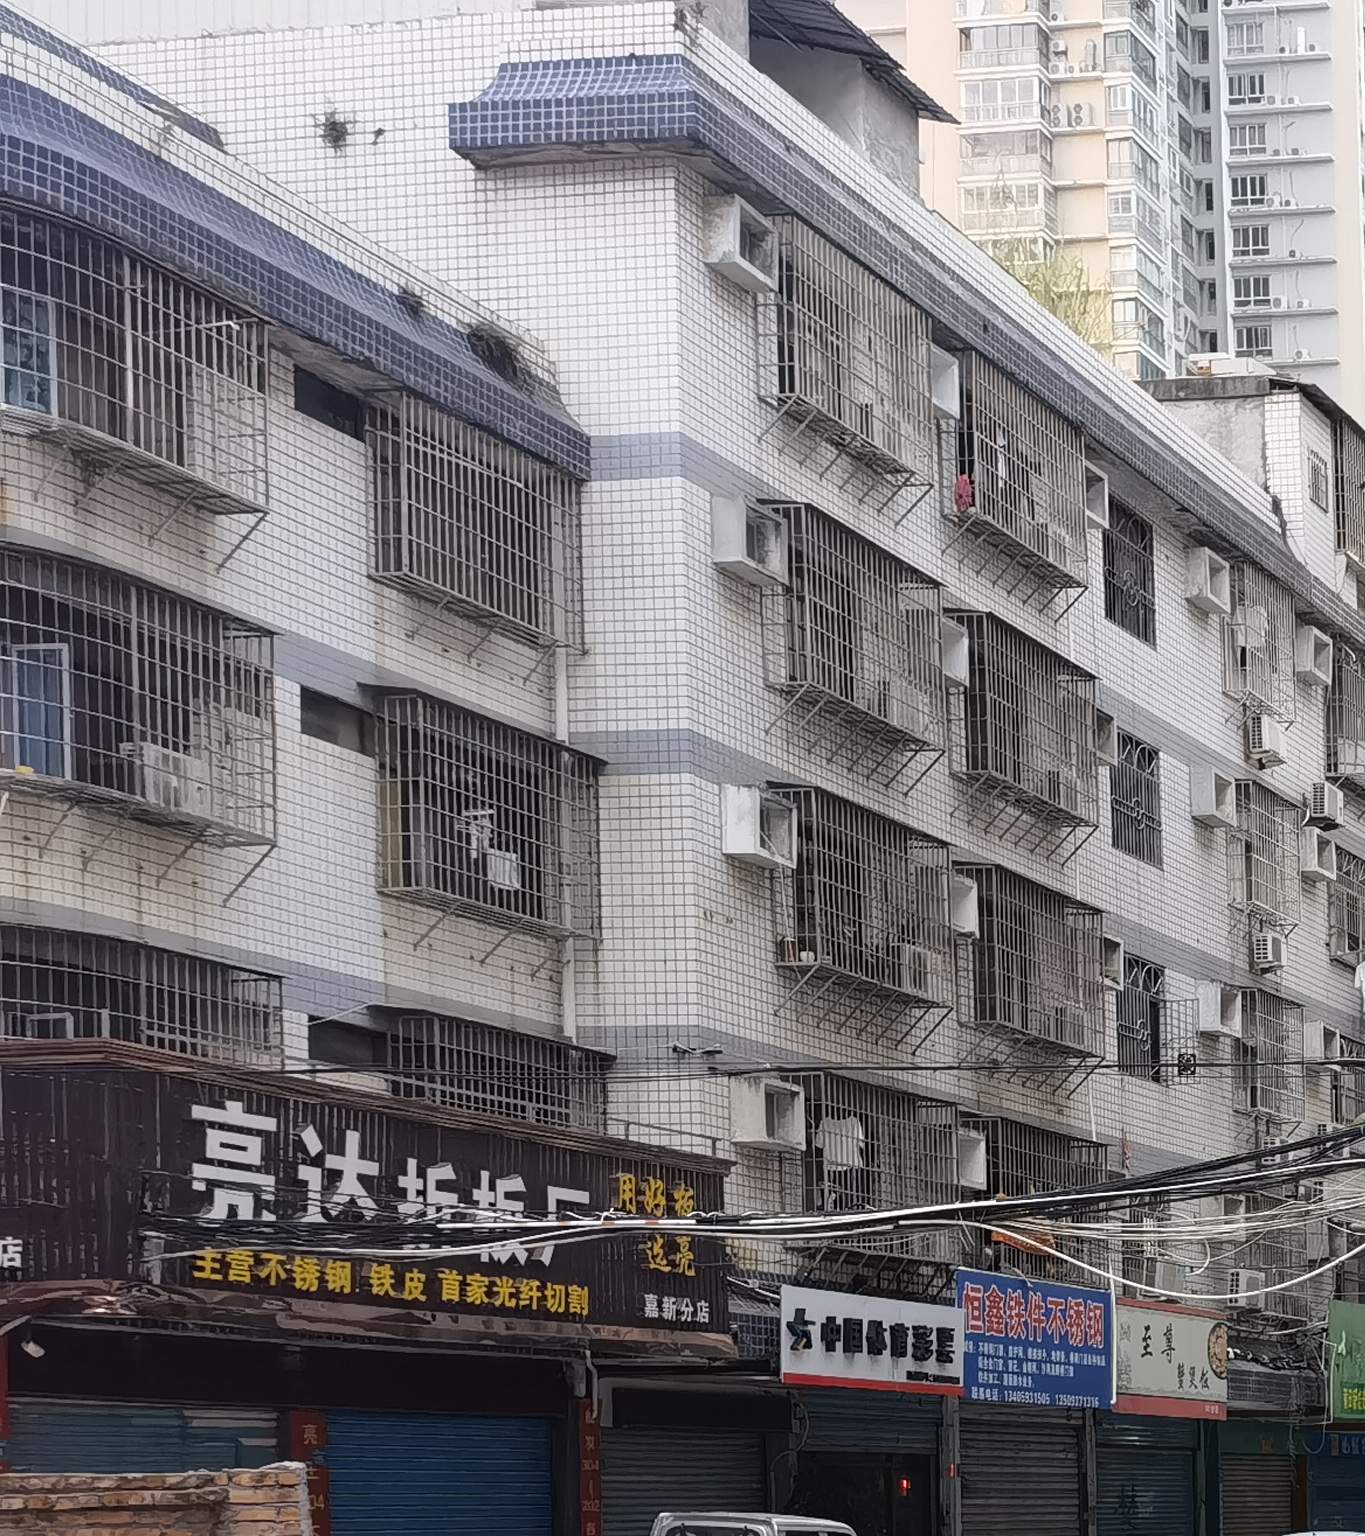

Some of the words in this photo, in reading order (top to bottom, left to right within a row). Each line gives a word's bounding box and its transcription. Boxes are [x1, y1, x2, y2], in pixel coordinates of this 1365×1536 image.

[193, 1246, 352, 1295] 主营不锈钢
[370, 1262, 428, 1302] 铁皮
[439, 1270, 590, 1316] 首家光纤切割
[644, 1294, 710, 1325] 嘉新分店
[963, 1281, 1105, 1349] 恒鑫铁件不锈钢
